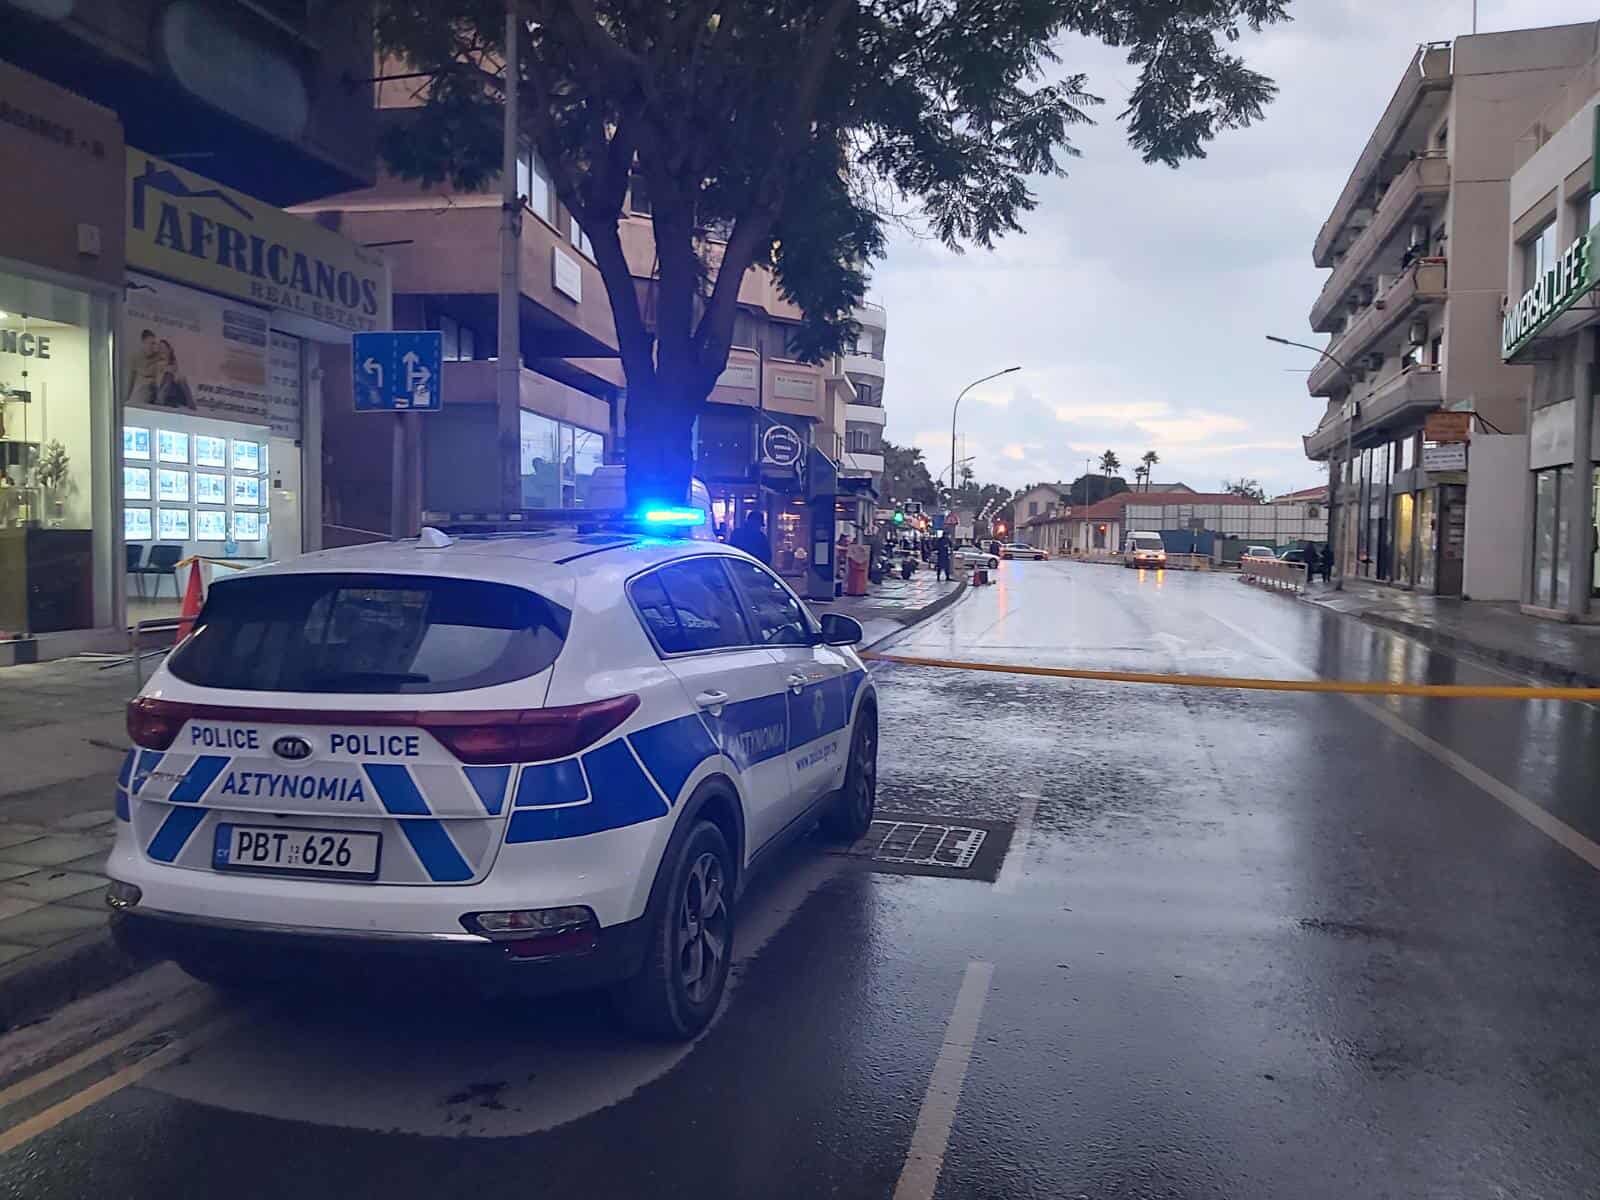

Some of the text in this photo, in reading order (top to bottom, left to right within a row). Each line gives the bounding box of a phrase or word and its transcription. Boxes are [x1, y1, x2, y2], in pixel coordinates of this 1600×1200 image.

[155, 201, 378, 316] AFRICANOS
[1553, 236, 1581, 304] LIFE
[250, 280, 305, 311] REAL
[191, 726, 259, 750] POLICE
[330, 733, 420, 757] POLICE
[221, 770, 365, 803] ΑΣΤΥΝΟΜΙΑ
[236, 831, 351, 867] PBT 626
